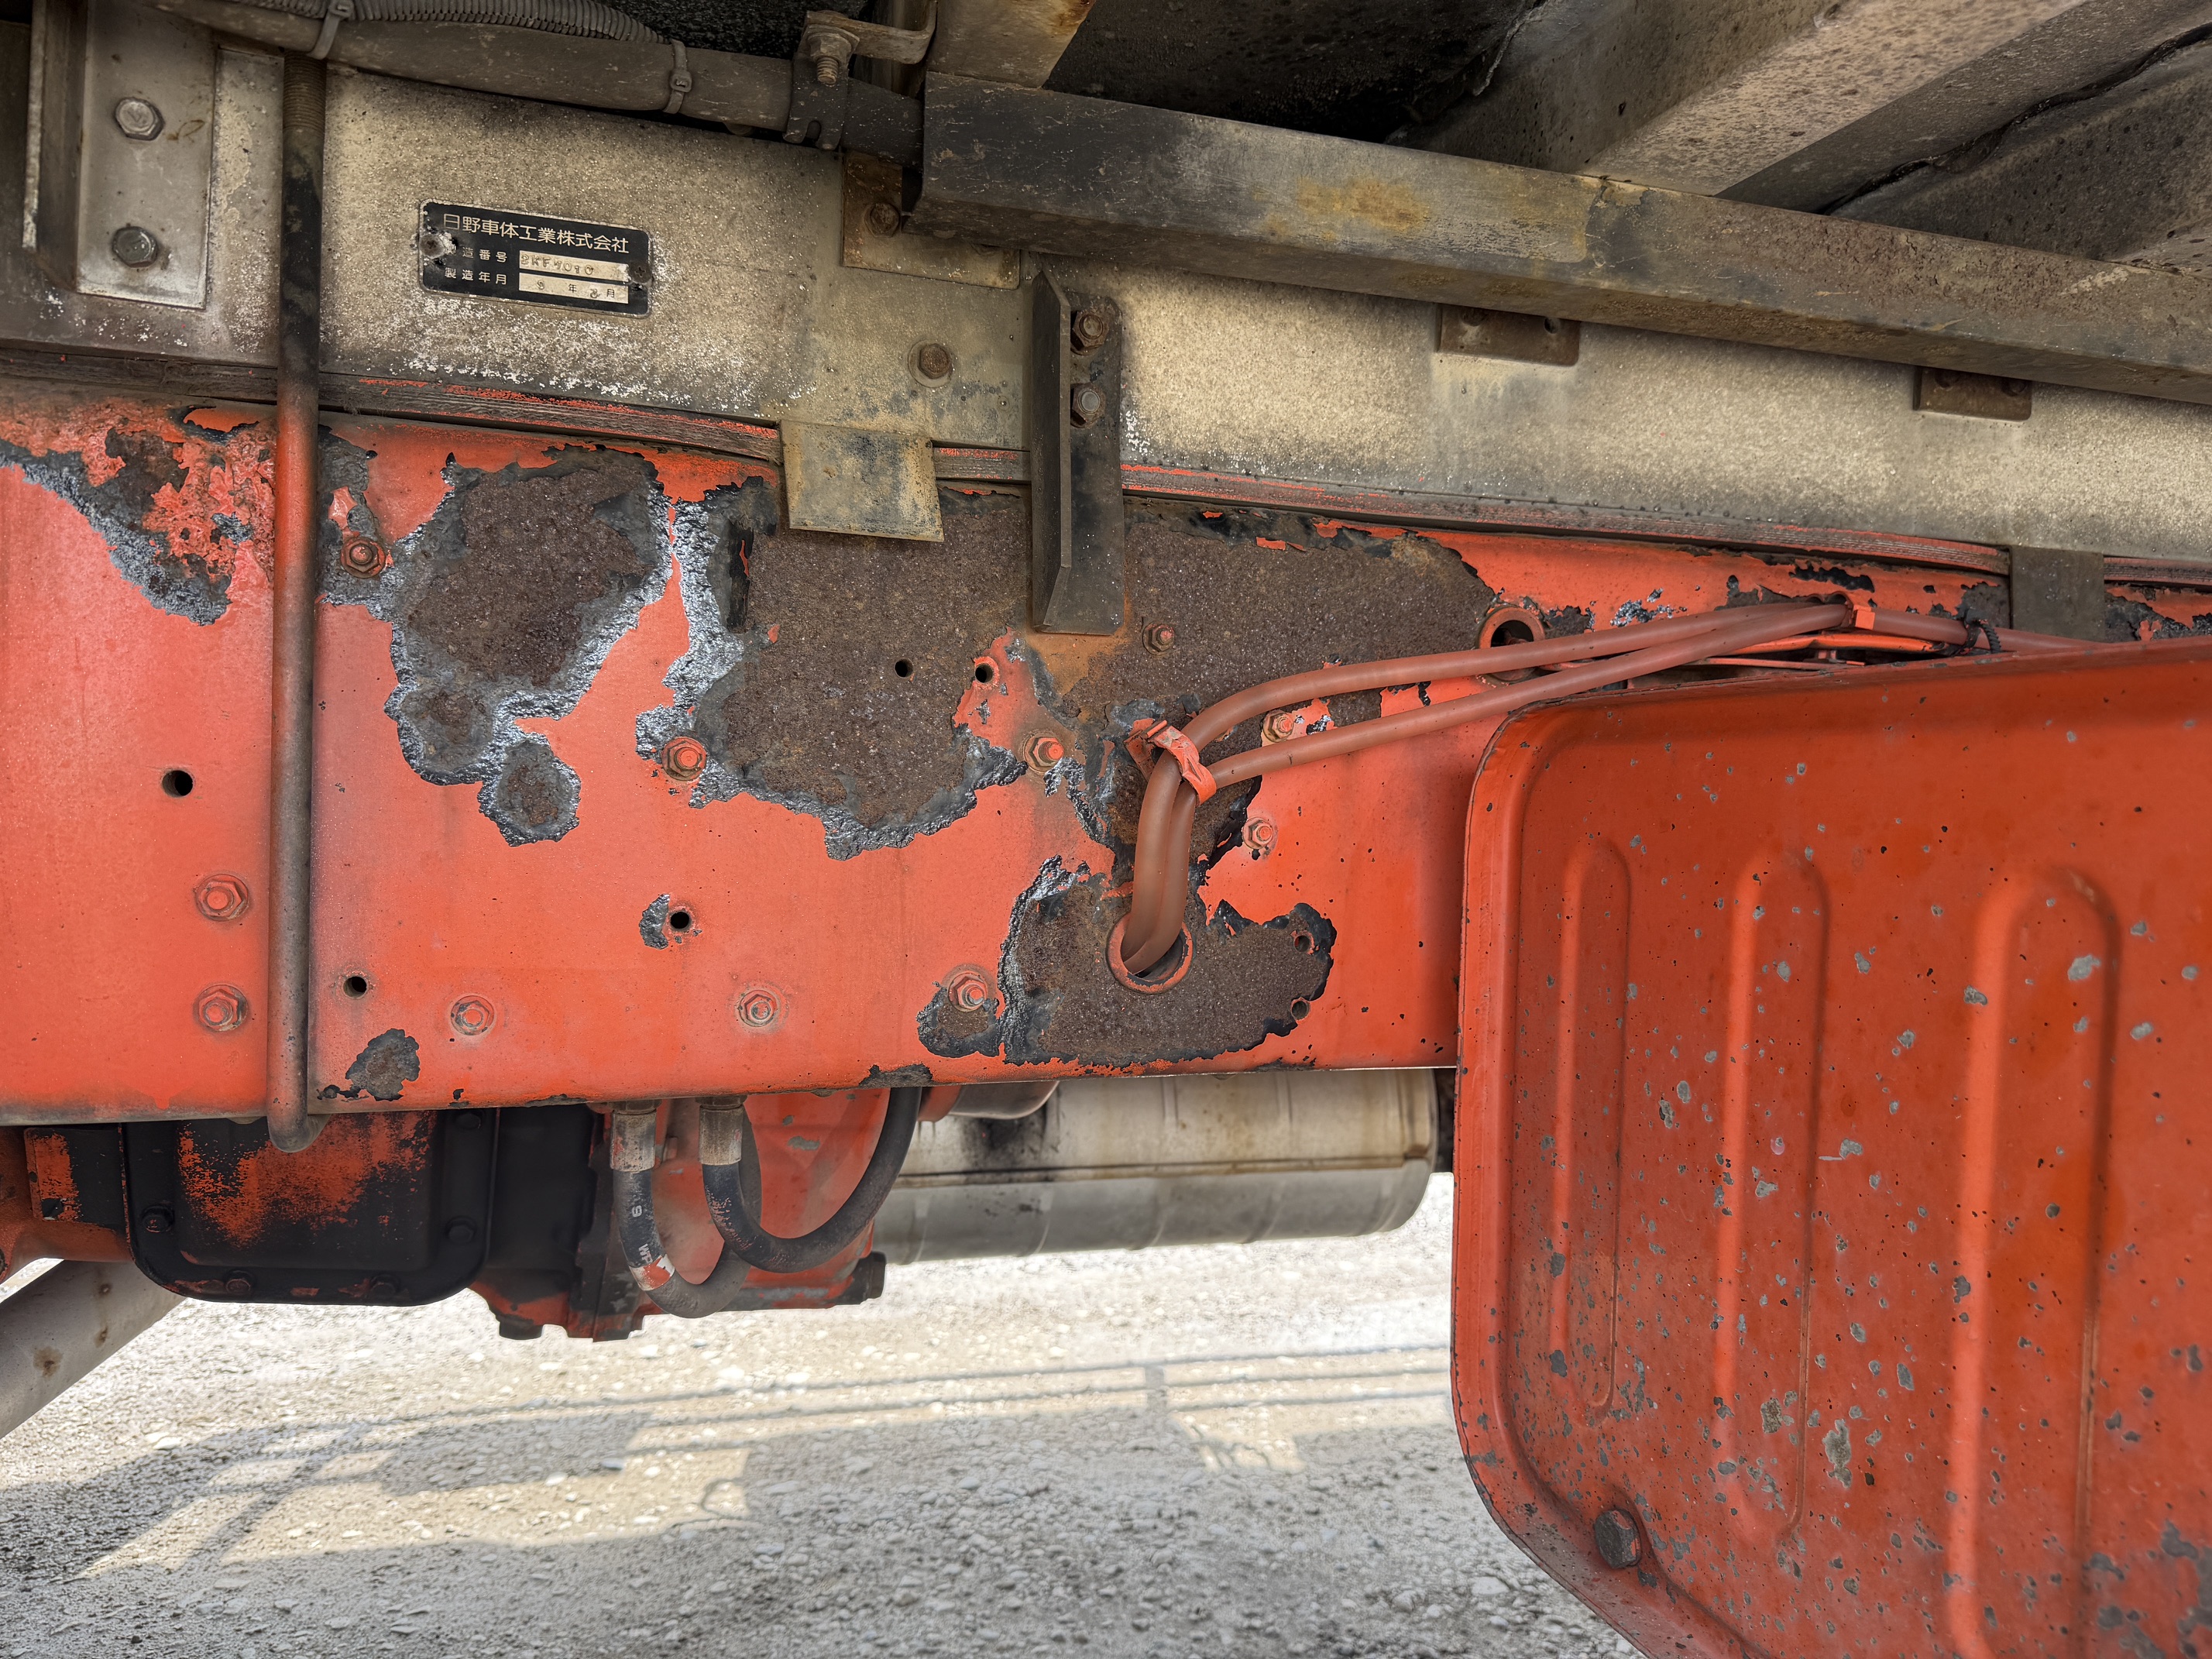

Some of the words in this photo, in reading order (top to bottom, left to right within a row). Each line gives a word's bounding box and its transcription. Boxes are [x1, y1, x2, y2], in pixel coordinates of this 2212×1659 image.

[442, 213, 630, 254] 日野車体工業株式会社
[444, 267, 507, 285] 製造年月
